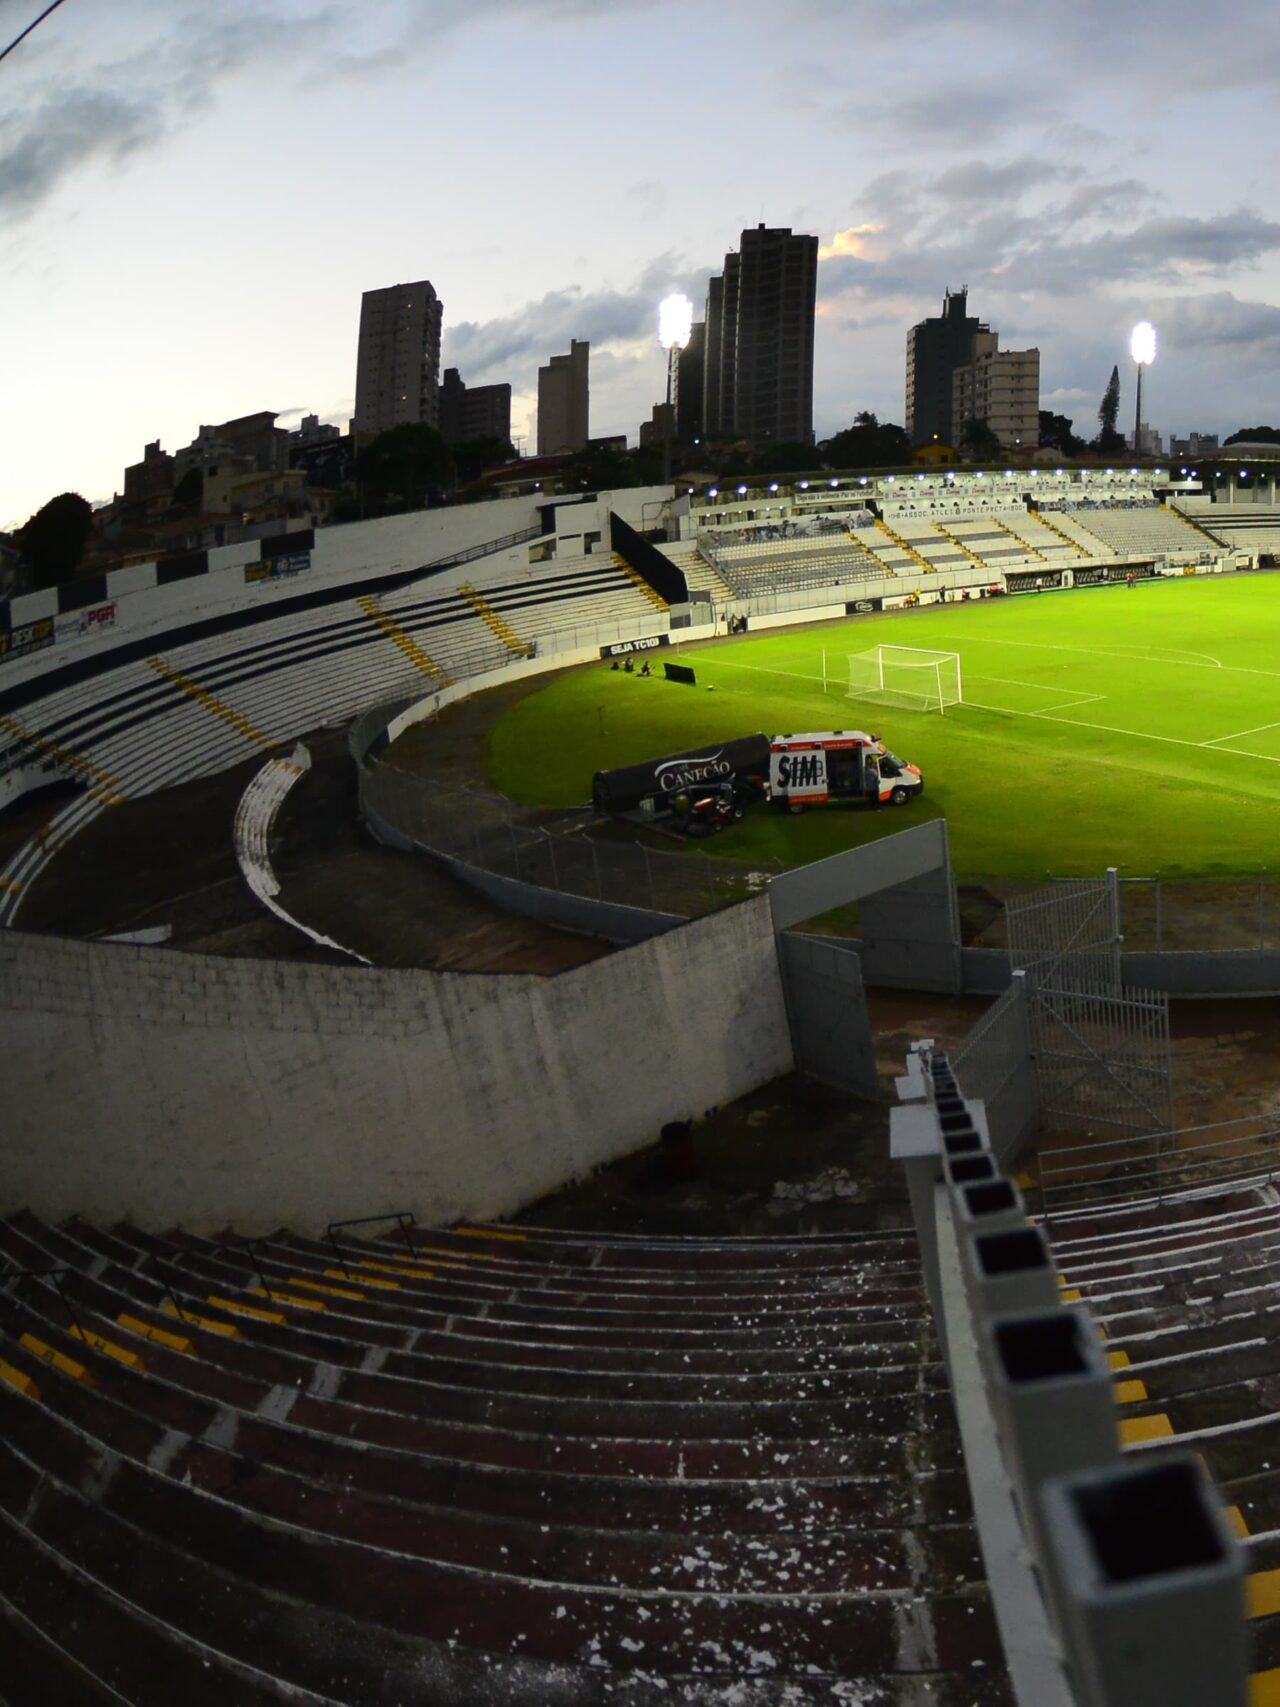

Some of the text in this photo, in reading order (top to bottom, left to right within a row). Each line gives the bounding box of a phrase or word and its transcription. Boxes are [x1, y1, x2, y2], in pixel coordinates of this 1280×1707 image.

[610, 642, 634, 655] SEJA
[660, 760, 730, 792] CANECÃO
[777, 754, 818, 788] SIM
